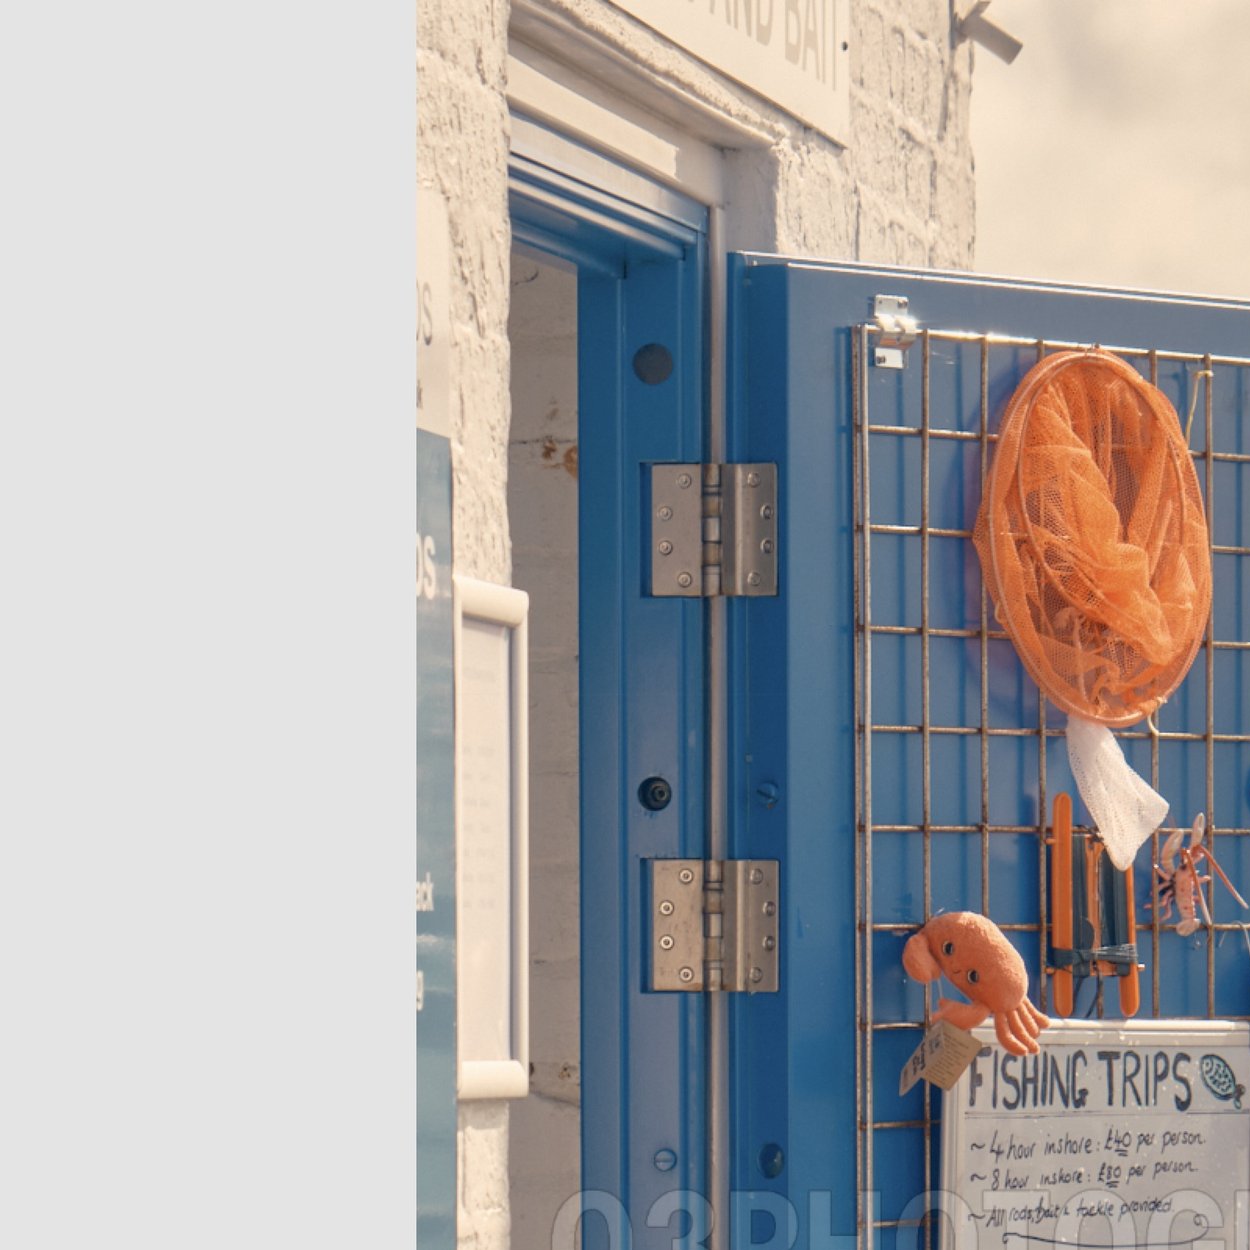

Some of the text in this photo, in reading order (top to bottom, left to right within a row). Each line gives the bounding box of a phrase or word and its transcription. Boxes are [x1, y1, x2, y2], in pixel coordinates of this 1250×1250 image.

[968, 1046, 1089, 1111] FISHING
[1097, 1050, 1192, 1112] TRIPS
[990, 1130, 1004, 1163] 4
[1006, 1133, 1036, 1160] hour
[1104, 1127, 1132, 1152] £40
[1136, 1131, 1155, 1153] per
[991, 1168, 1000, 1191] 8
[1005, 1168, 1029, 1189] hour
[1097, 1162, 1122, 1183] £80
[1126, 1164, 1146, 1184] per
[985, 1206, 1005, 1227] All
[1077, 1198, 1115, 1217] tackle
